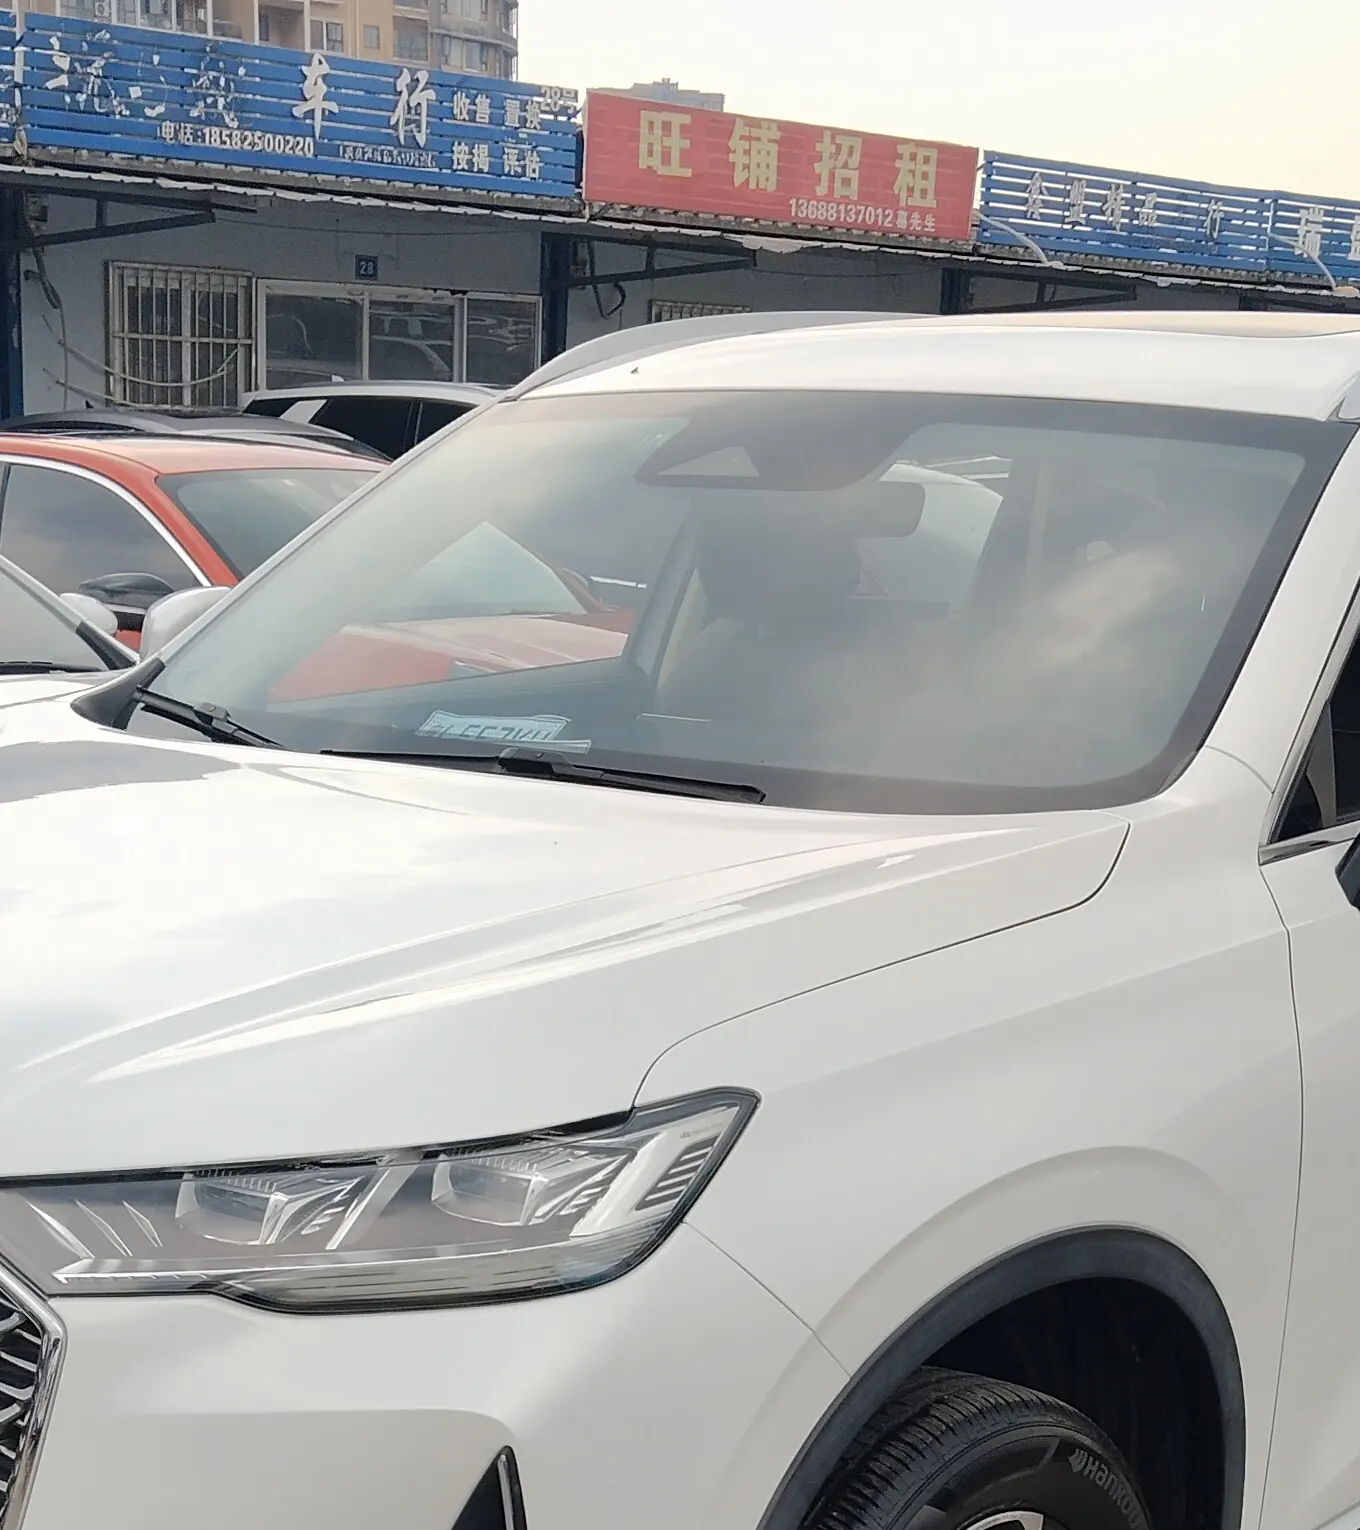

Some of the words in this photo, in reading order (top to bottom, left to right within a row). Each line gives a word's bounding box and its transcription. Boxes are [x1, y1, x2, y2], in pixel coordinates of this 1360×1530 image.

[292, 53, 436, 148] 车行
[540, 86, 578, 114] 28号
[639, 109, 938, 208] 旺铺招租
[360, 260, 374, 275] 28
